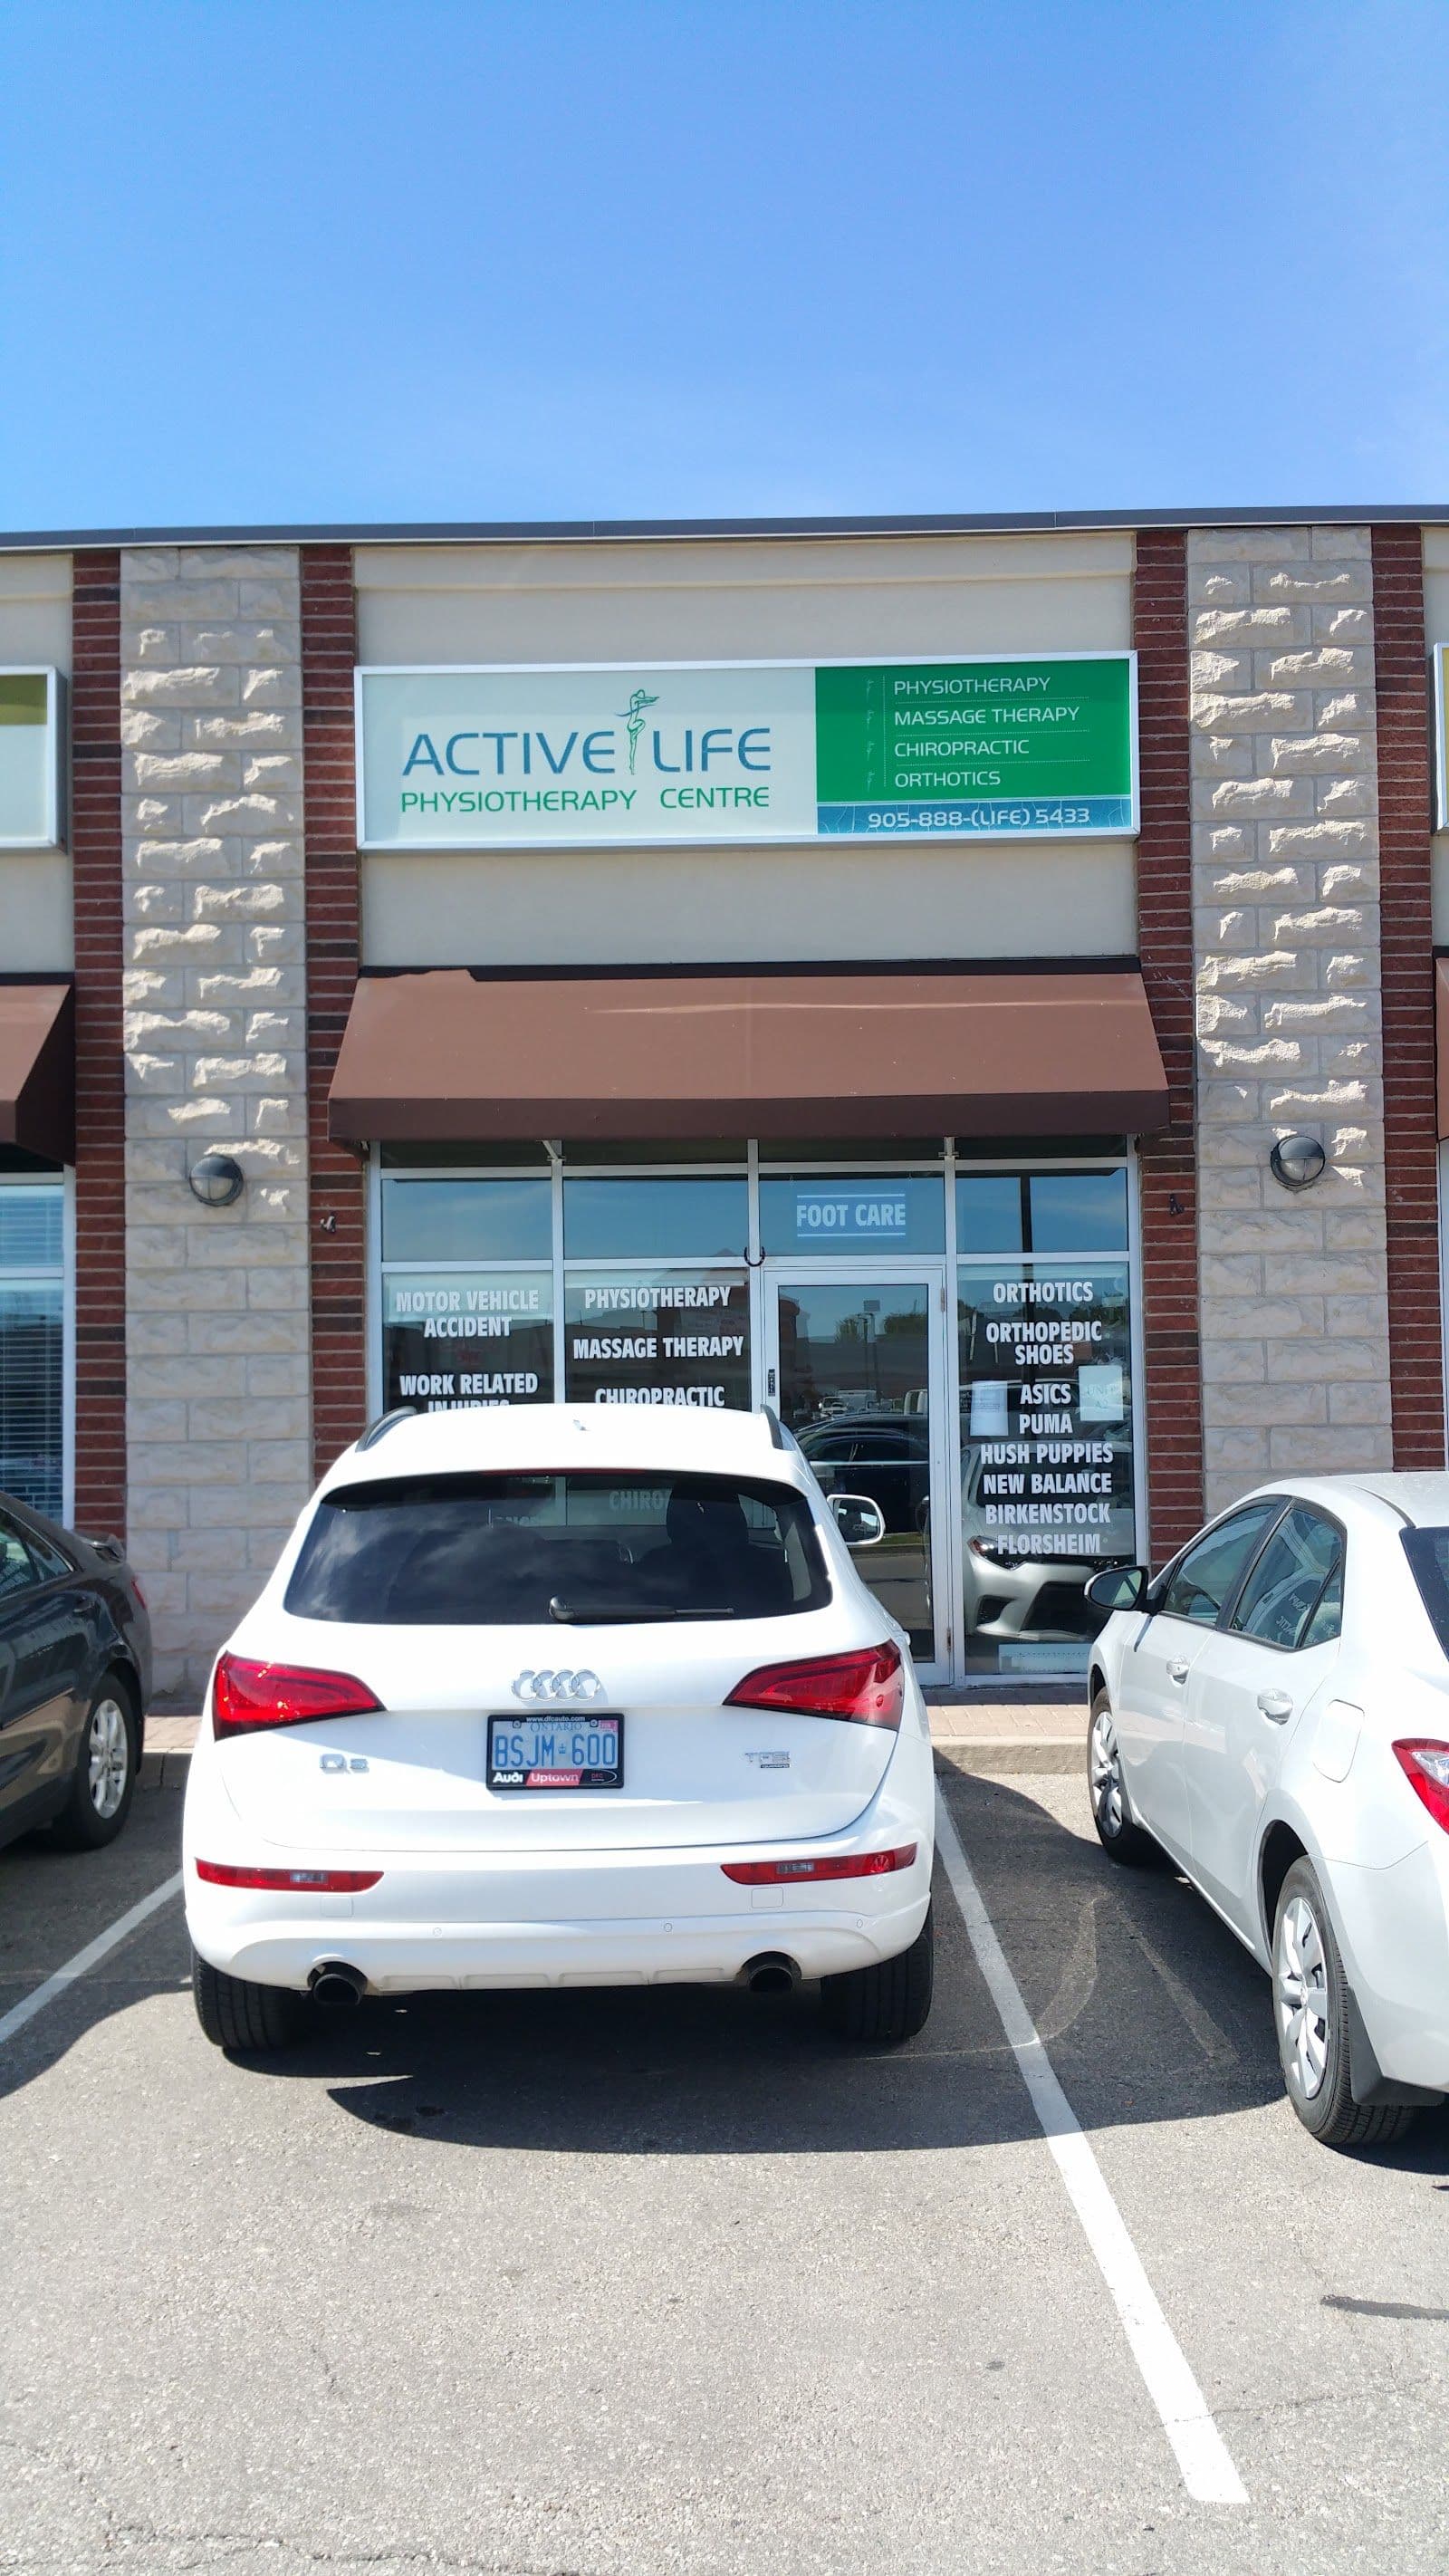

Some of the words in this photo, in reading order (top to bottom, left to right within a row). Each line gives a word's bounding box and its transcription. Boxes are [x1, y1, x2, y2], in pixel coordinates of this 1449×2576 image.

[895, 677, 1051, 696] PHYSIOTHERAPY
[895, 709, 986, 726] MASSAGE
[991, 706, 1080, 723] THERAPY
[402, 730, 616, 776] ACTIVE
[652, 727, 772, 772] LIFE
[895, 739, 1030, 757] CHIROPRACTIC
[895, 771, 1001, 787] ORTHOTICS
[400, 790, 638, 812] PHYSIOTHERAPY
[660, 786, 771, 809] CENTRE
[868, 809, 1031, 828] 905-888-(LIFE)
[1035, 808, 1090, 825] 5433
[797, 1204, 847, 1226] FOOT
[855, 1203, 906, 1226] CARE
[396, 1291, 460, 1312] MOTOR
[466, 1290, 539, 1311] VEHICLE
[585, 1287, 731, 1309] PHYSIOTHERAPY
[993, 1281, 1093, 1303] ORTHOTICS
[424, 1316, 512, 1338] ACCIDENT
[986, 1321, 1101, 1342] ORTHOPEDIC
[573, 1337, 657, 1359] MASSAGE
[662, 1336, 744, 1358] THERAPY
[1015, 1344, 1074, 1366] SHOES
[400, 1374, 455, 1396] WORK
[460, 1373, 538, 1394] RELATED
[1020, 1383, 1072, 1405] ASICS
[595, 1387, 724, 1408] CHIROPRACTIC
[1019, 1413, 1073, 1435] PUMA
[981, 1444, 1031, 1465] HUSH
[1036, 1442, 1113, 1464] PUPPIES
[984, 1474, 1025, 1495] NEW
[1031, 1473, 1112, 1495] BALANCE
[985, 1503, 1110, 1524] BIRKENSTOCK
[997, 1533, 1100, 1555] FLORSHEIM
[531, 1722, 582, 1732] ONTARIO
[494, 1735, 555, 1767] BSJM
[572, 1734, 616, 1765] 600
[493, 1773, 523, 1783] Audi
[531, 1773, 580, 1783] Uptown
